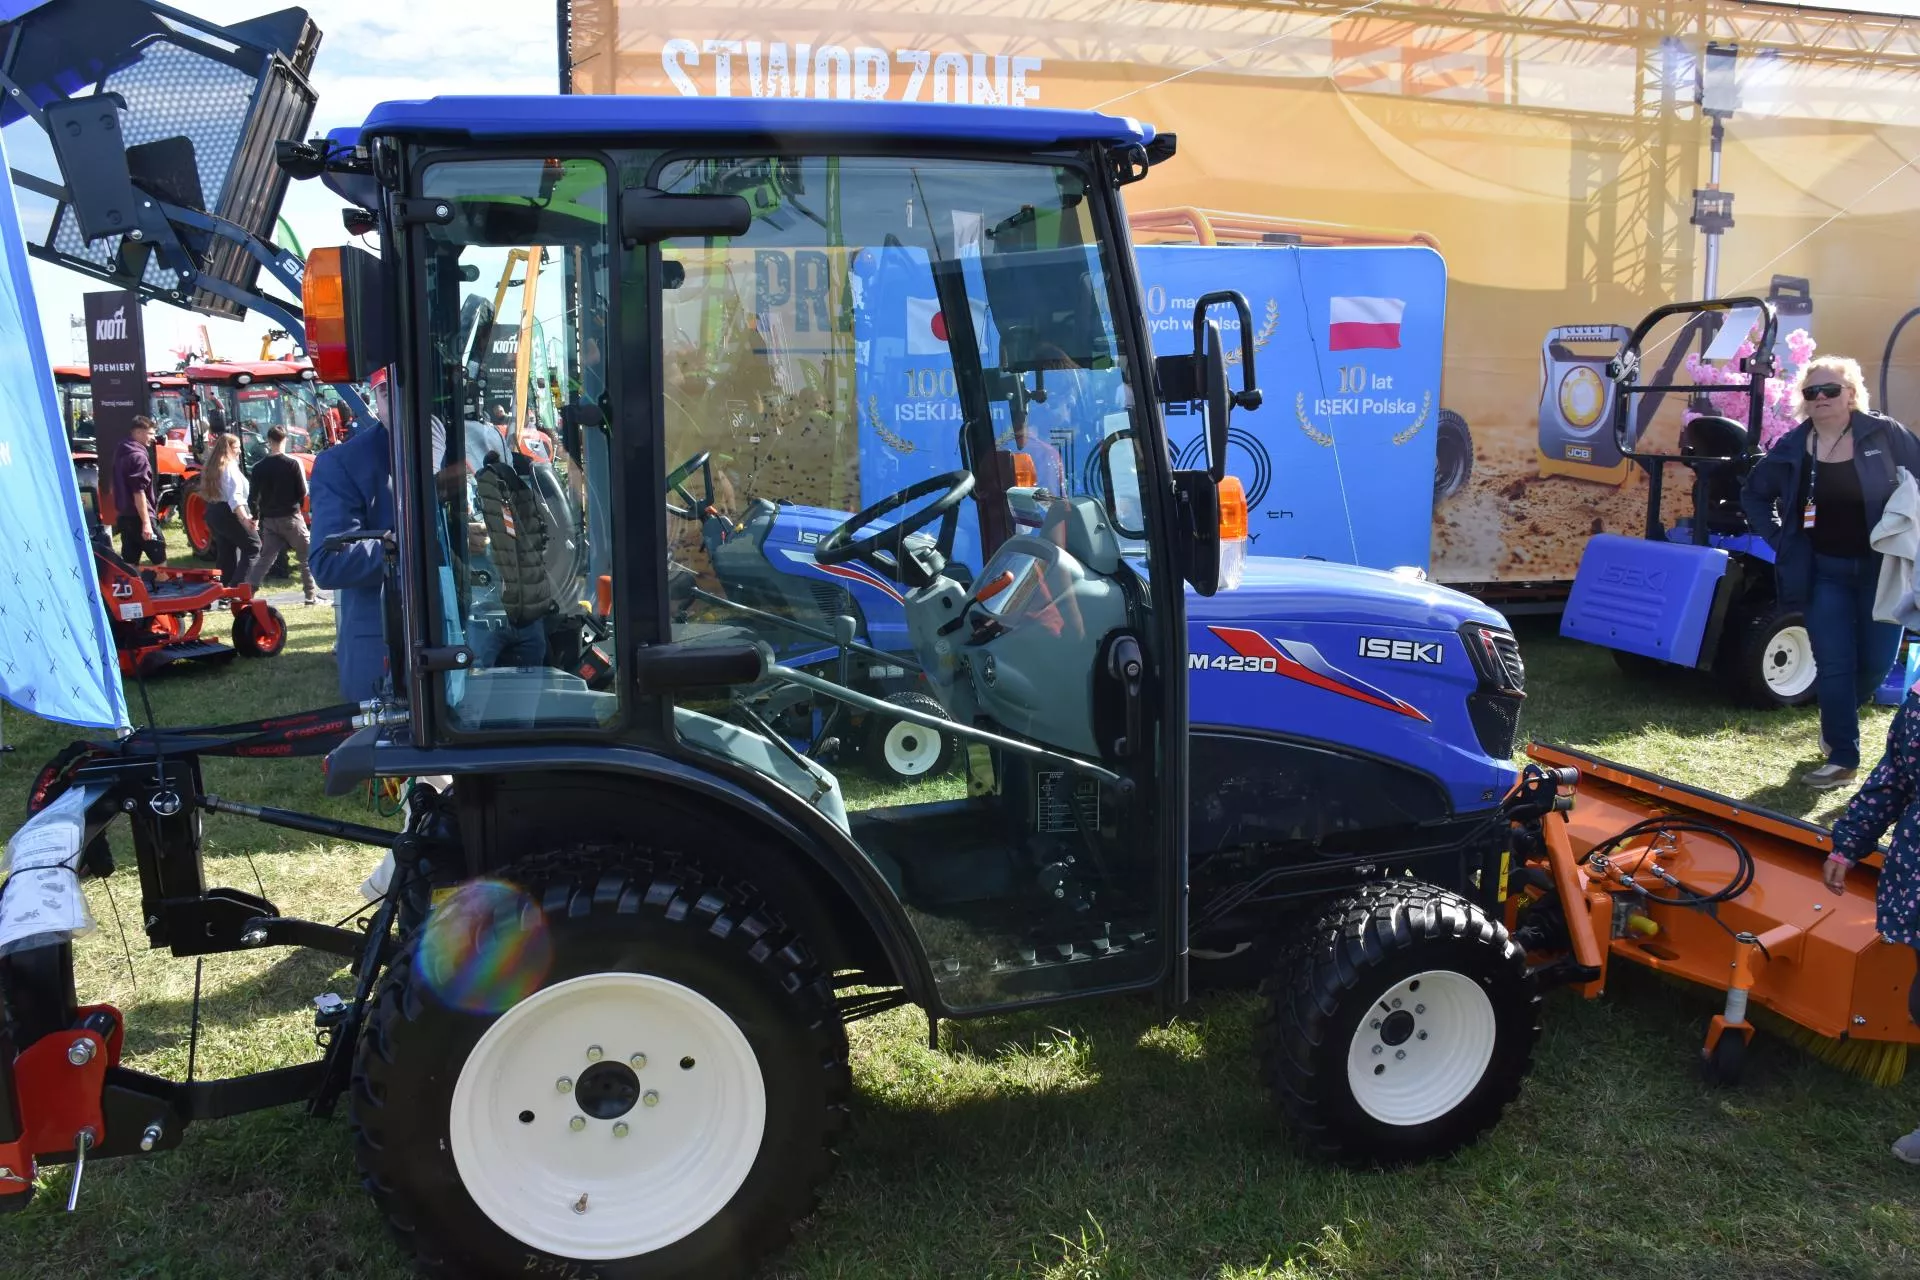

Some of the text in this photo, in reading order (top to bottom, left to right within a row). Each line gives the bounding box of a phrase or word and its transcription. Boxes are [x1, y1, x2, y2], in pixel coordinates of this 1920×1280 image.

[96, 319, 126, 340] KIOTI
[94, 363, 136, 372] PREMIERY
[1339, 364, 1393, 394] 10 lat
[895, 403, 1005, 421] ISEKI Jan
[1314, 397, 1416, 416] ISEKI Polska
[1568, 447, 1589, 458] JCB
[1358, 636, 1444, 664] ISEKI
